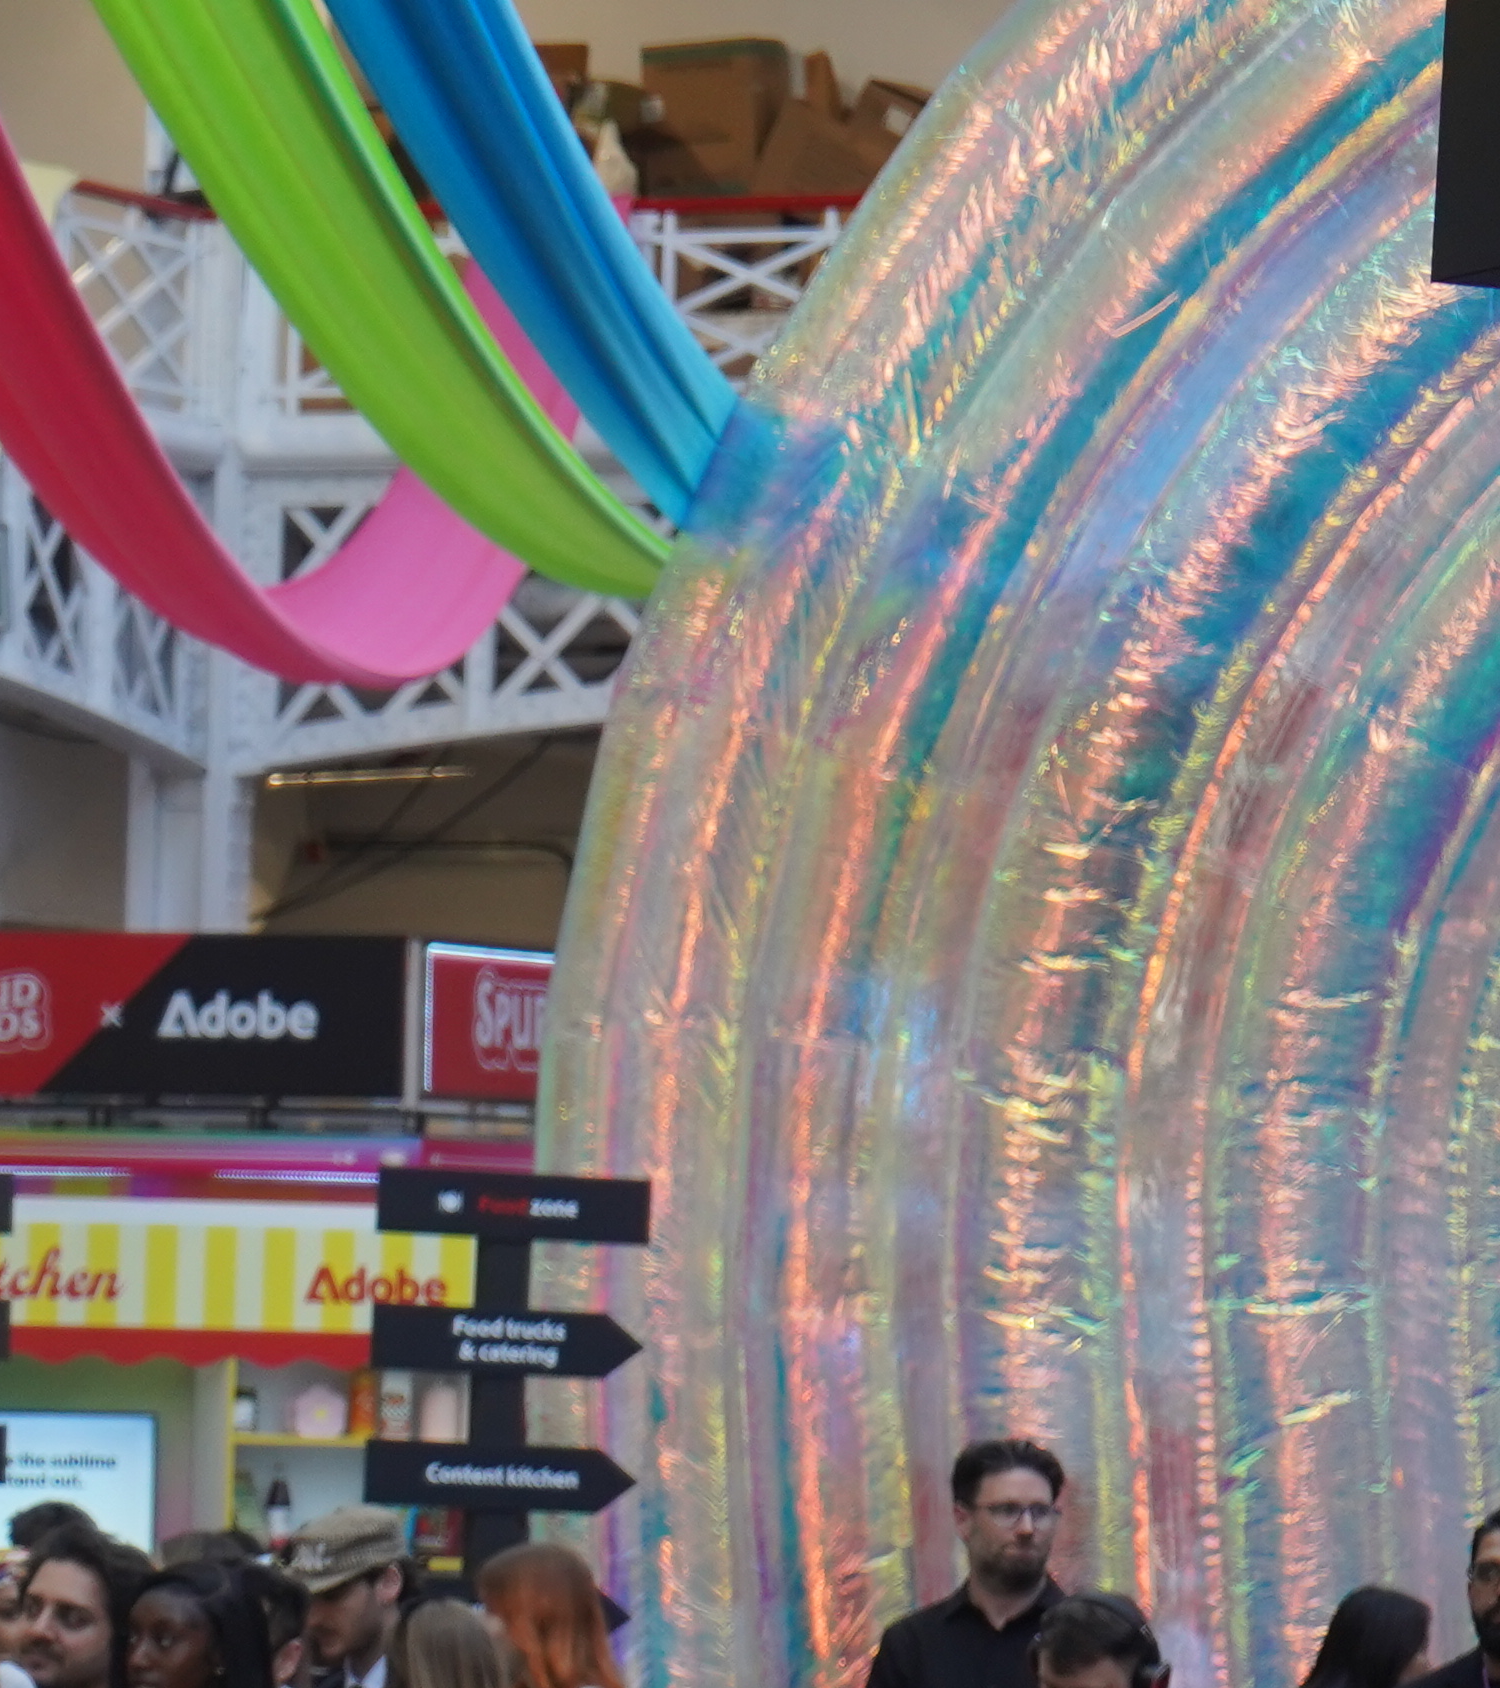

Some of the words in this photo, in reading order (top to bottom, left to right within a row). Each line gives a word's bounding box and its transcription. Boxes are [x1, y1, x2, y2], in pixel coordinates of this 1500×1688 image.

[157, 989, 320, 1039] Adobe
[530, 1197, 580, 1218] zone
[304, 1264, 448, 1307] Adobe
[453, 1313, 504, 1339] Food
[506, 1316, 568, 1342] trucks
[478, 1341, 560, 1369] catering
[6, 1472, 46, 1487] tand
[425, 1460, 502, 1486] Content
[504, 1463, 580, 1490] kitchen
